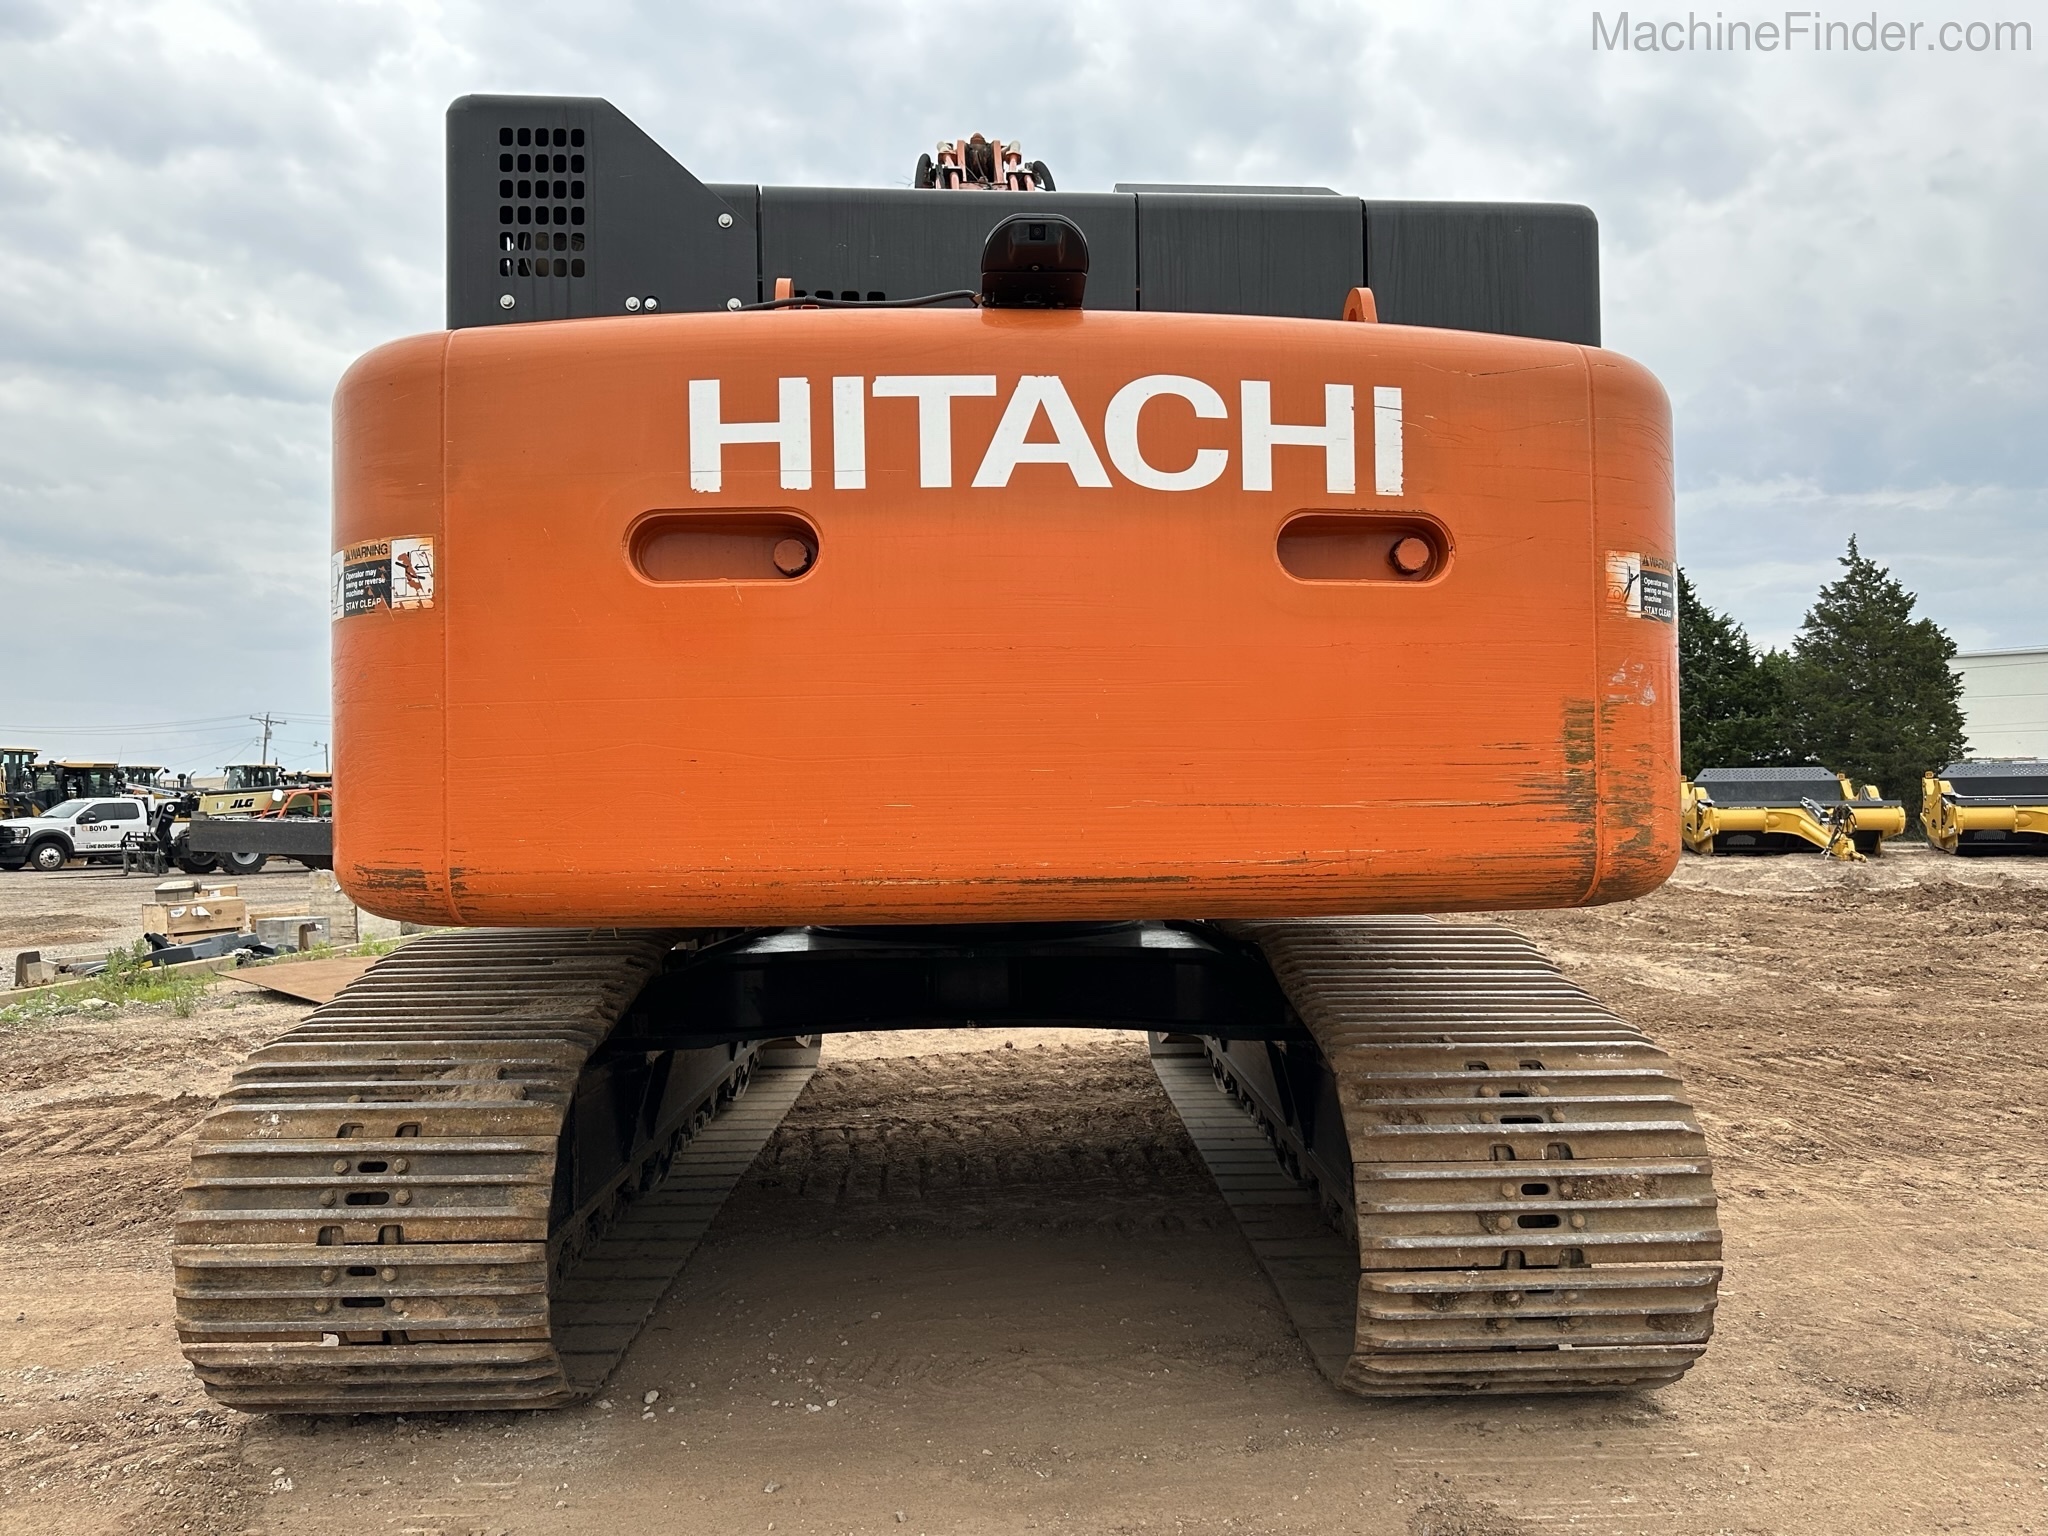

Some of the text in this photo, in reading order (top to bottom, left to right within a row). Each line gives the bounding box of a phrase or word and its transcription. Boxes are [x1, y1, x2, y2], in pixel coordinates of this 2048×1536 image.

[688, 374, 1404, 497] HITACHI
[350, 544, 387, 559] WARNING
[346, 569, 377, 580] Operator may
[346, 581, 358, 590] swing
[365, 577, 385, 585] reverse
[346, 589, 364, 597] machine
[346, 600, 359, 611] STAY
[1644, 606, 1671, 617] STAY CLEAR
[230, 798, 254, 808] JLG
